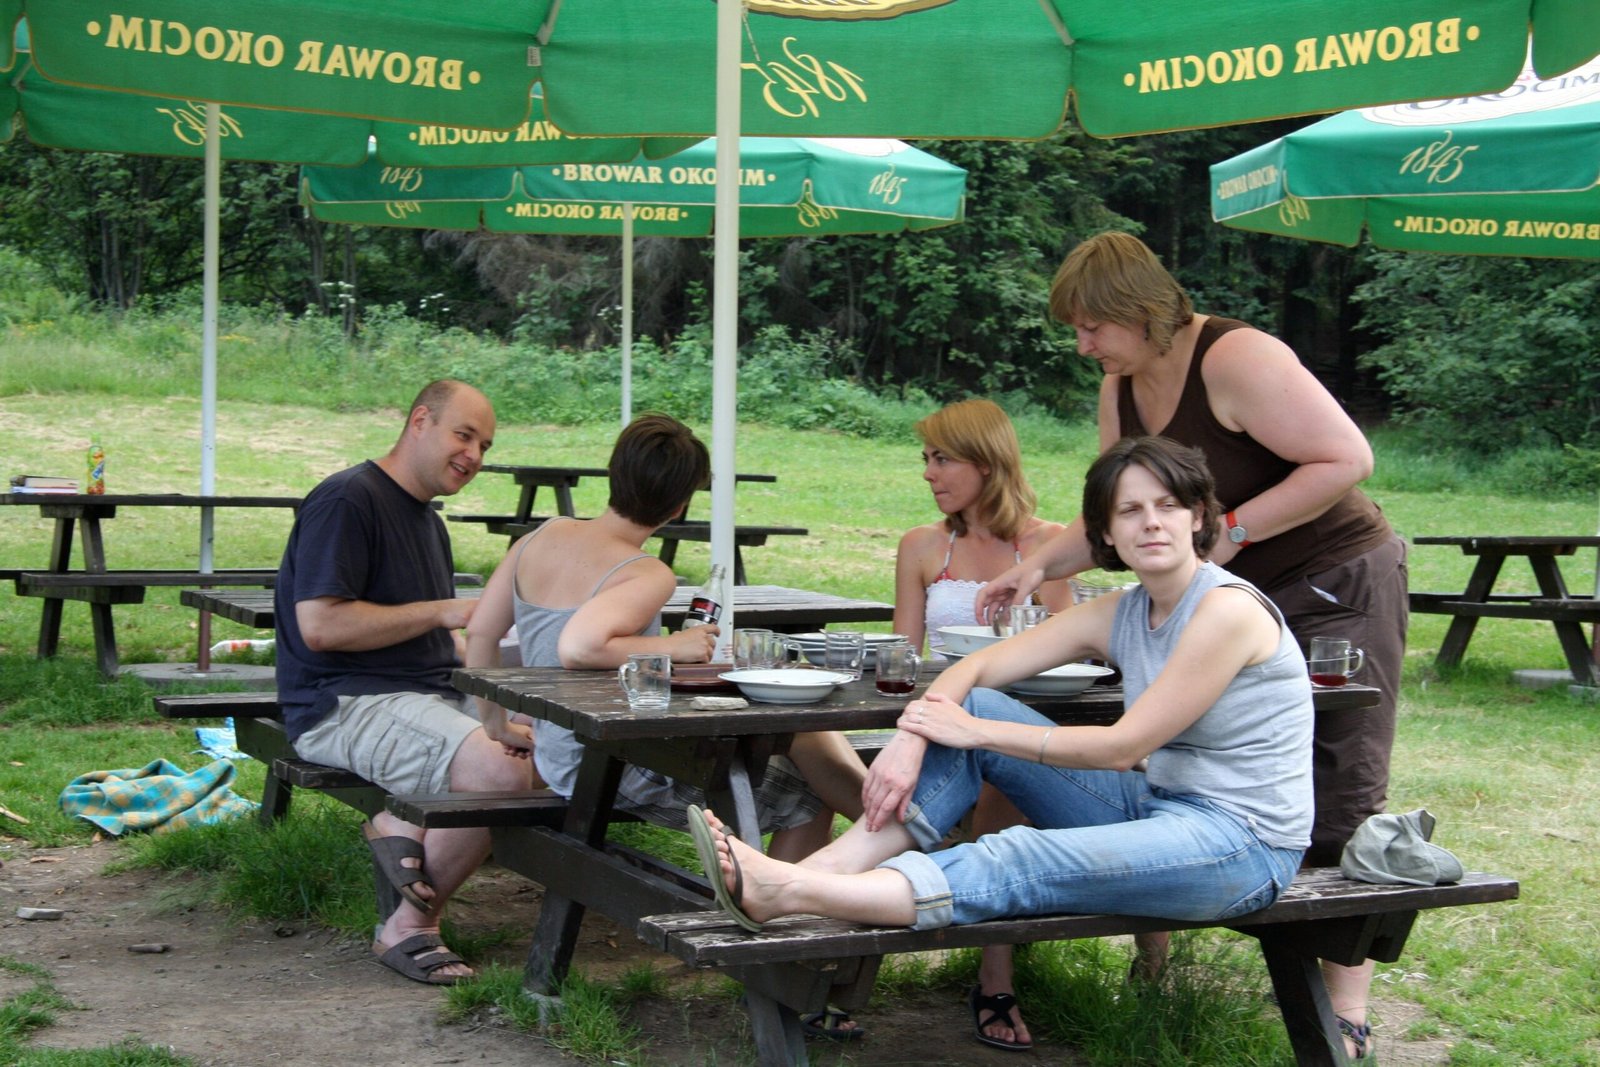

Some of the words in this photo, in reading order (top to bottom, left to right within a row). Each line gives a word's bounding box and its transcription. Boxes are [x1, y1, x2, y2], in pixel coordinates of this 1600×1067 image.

[563, 164, 664, 183] BROWAR
[669, 167, 766, 186] OKOIM
[1400, 130, 1479, 184] 1845
[868, 162, 908, 205] 1845
